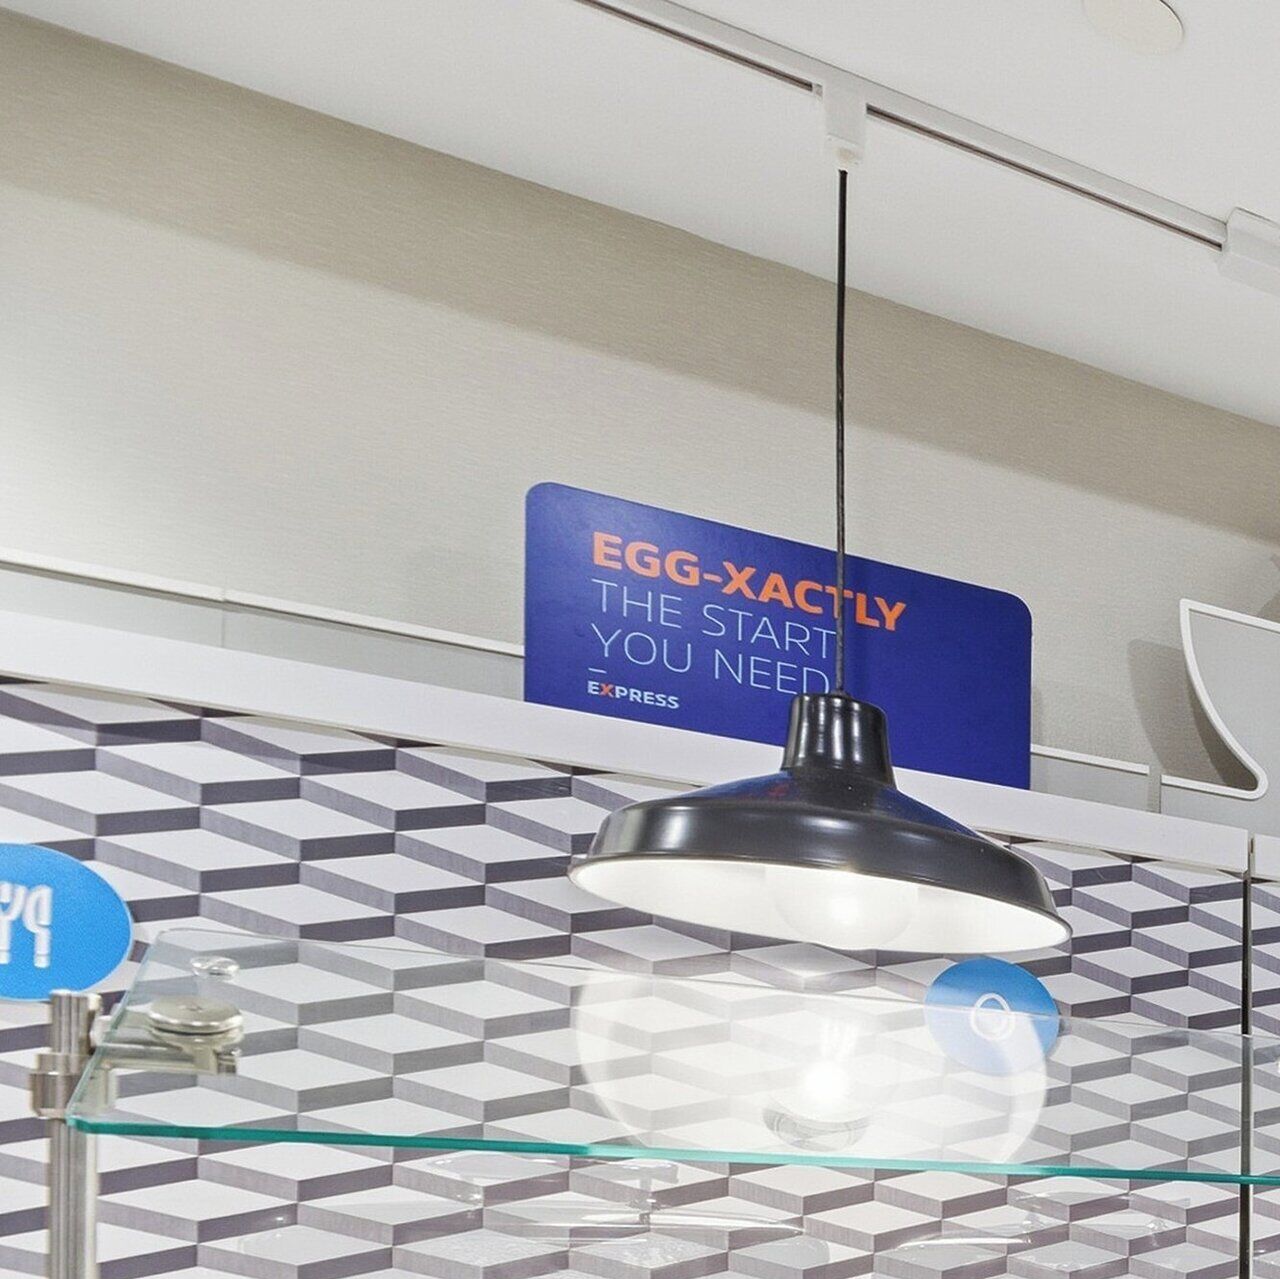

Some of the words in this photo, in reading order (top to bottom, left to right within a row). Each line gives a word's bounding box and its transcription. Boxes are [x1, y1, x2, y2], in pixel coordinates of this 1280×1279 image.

[591, 530, 907, 632] EGG-XACTLY
[591, 578, 683, 630] THE
[702, 604, 837, 660] START
[587, 679, 681, 710] EXPRESS
[591, 621, 693, 674] YOU
[713, 647, 831, 695] NEED
